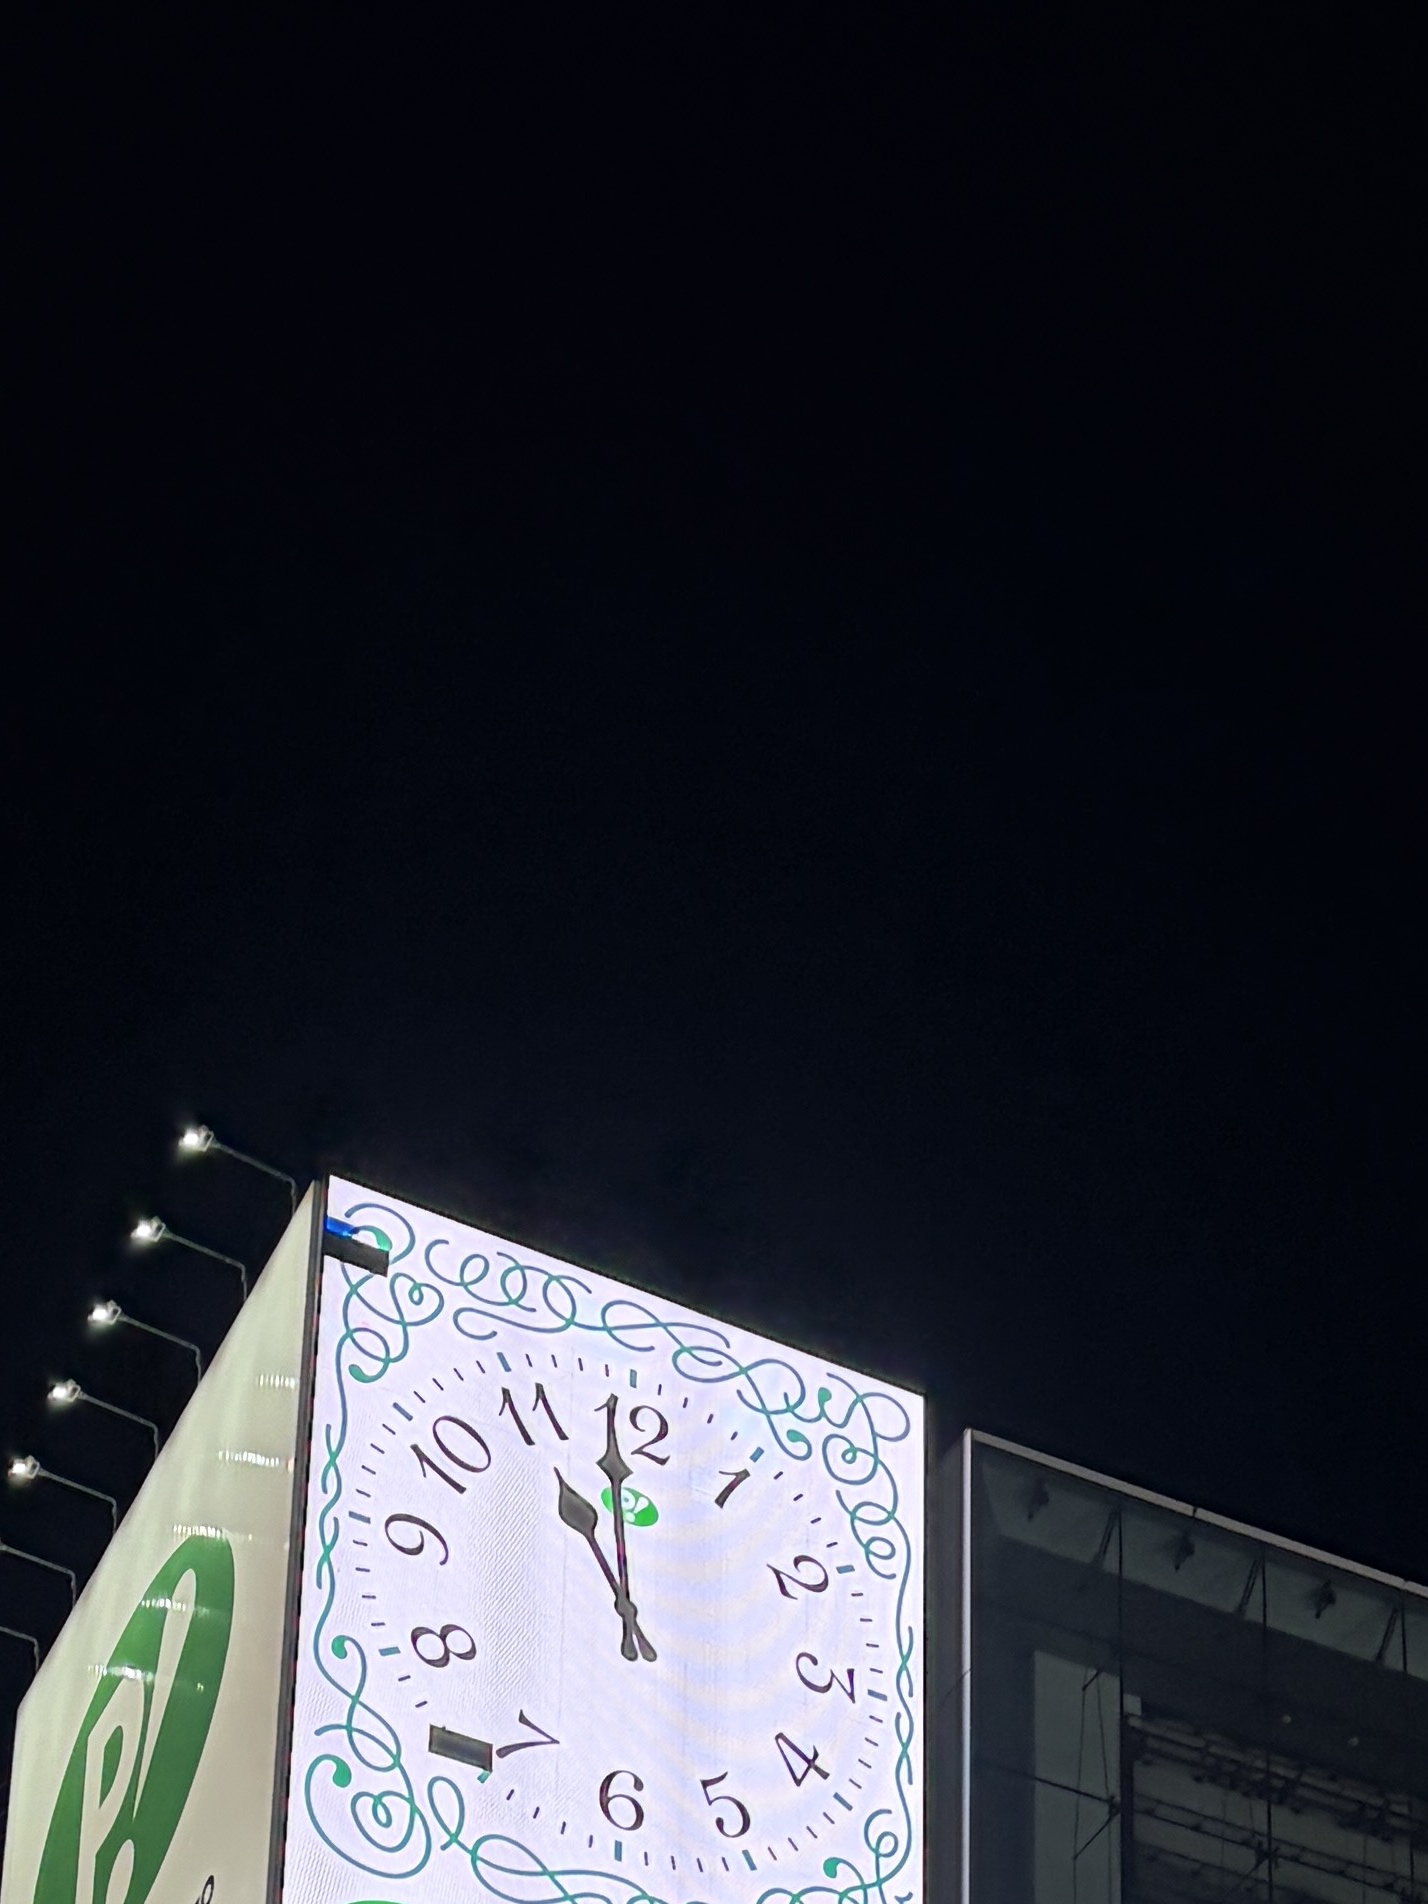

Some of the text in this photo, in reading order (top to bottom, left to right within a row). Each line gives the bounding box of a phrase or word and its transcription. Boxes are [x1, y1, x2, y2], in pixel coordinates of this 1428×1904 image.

[499, 1384, 568, 1446] 11
[417, 1414, 492, 1493] 10
[717, 1466, 754, 1510] 1
[384, 1513, 448, 1566] 9
[769, 1554, 829, 1602] 2
[410, 1624, 478, 1669] 8
[795, 1652, 858, 1701] 3
[772, 1732, 830, 1787] 4
[599, 1770, 645, 1834] 6
[701, 1774, 751, 1839] 5
